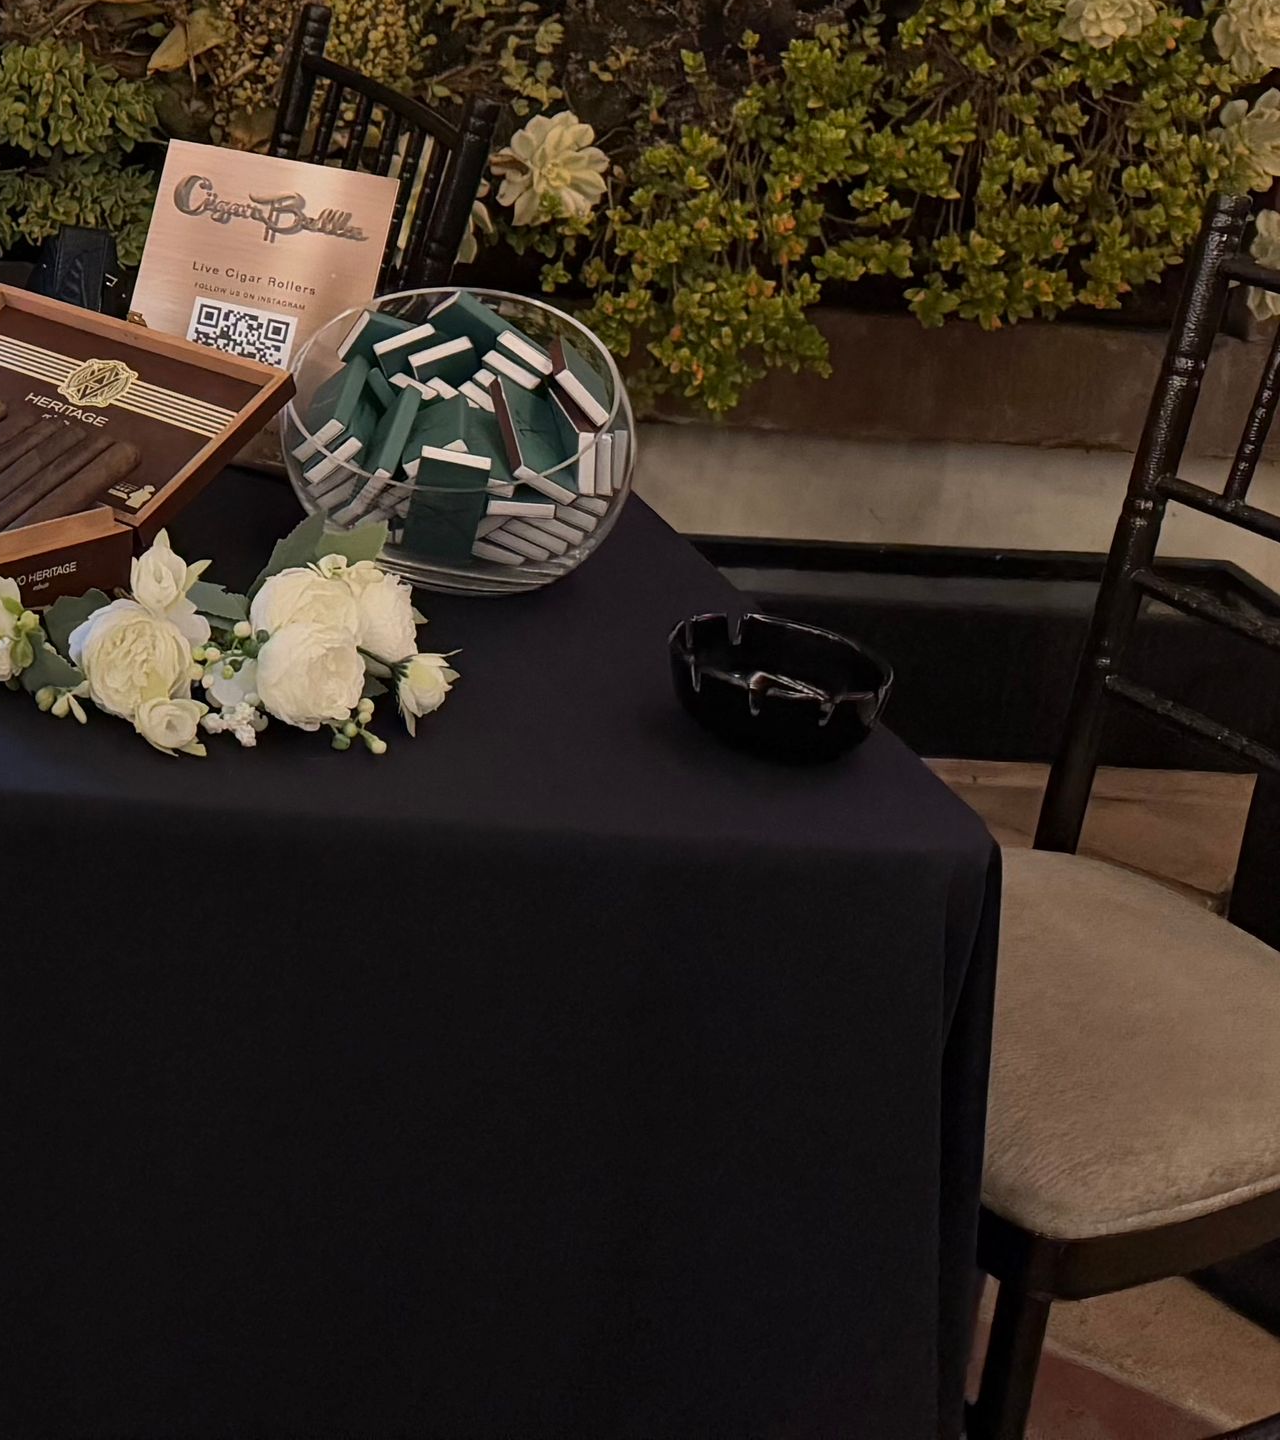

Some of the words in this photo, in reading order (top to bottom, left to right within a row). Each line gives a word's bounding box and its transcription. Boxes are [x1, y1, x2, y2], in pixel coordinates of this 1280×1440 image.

[192, 261, 220, 275] Live
[225, 268, 262, 283] Cigar
[267, 277, 316, 296] Rollers
[194, 282, 227, 295] FOLLOW
[229, 289, 240, 297] US
[243, 292, 255, 300] ON
[257, 295, 306, 310] INSTAGRAM
[24, 392, 110, 428] HERITAGE
[28, 561, 77, 583] HERITAGE
